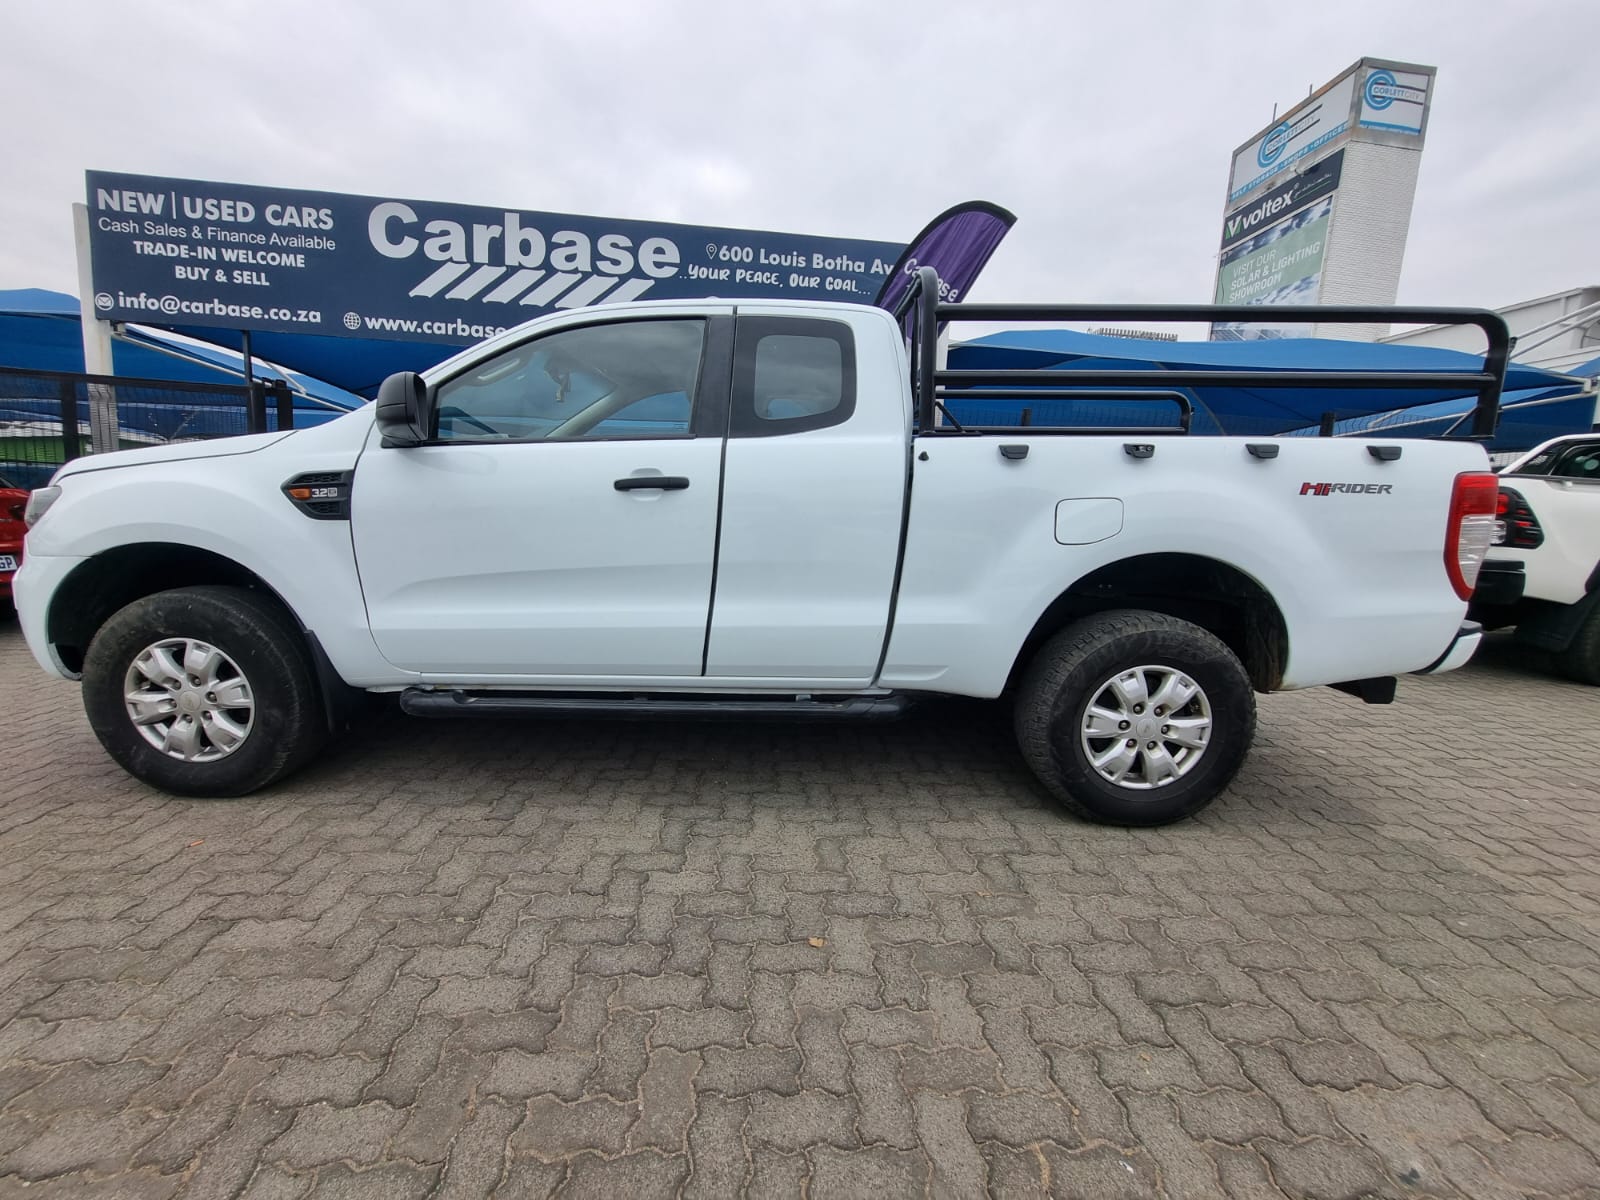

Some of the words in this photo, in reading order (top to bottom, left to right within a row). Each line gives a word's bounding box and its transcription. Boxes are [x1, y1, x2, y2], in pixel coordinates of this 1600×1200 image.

[96, 188, 165, 216] NEW
[183, 197, 256, 224] USED
[265, 204, 334, 231] CARS
[1242, 190, 1294, 230] voltex
[98, 217, 140, 234] Cash
[144, 220, 187, 238] Sales
[191, 225, 203, 240] &
[207, 227, 266, 245] Finance
[270, 234, 336, 251] Available
[368, 202, 681, 278] Carbase
[133, 240, 217, 261] TRADE-IN
[221, 248, 305, 268] WELCOME
[719, 245, 754, 263] 600
[760, 248, 806, 268] Louis
[812, 253, 866, 273] Botha
[1231, 270, 1262, 291] SOLAR
[1262, 266, 1270, 277] &
[1271, 241, 1322, 273] LIGHTING
[1233, 263, 1254, 278] VISIT
[1256, 250, 1277, 268] OUR
[175, 265, 210, 281] BUY
[215, 269, 228, 283] &
[233, 270, 270, 287] SELL
[789, 273, 819, 289] OUR
[1229, 271, 1283, 304] SHOWROOM
[118, 291, 322, 324] info@carbase.co.za
